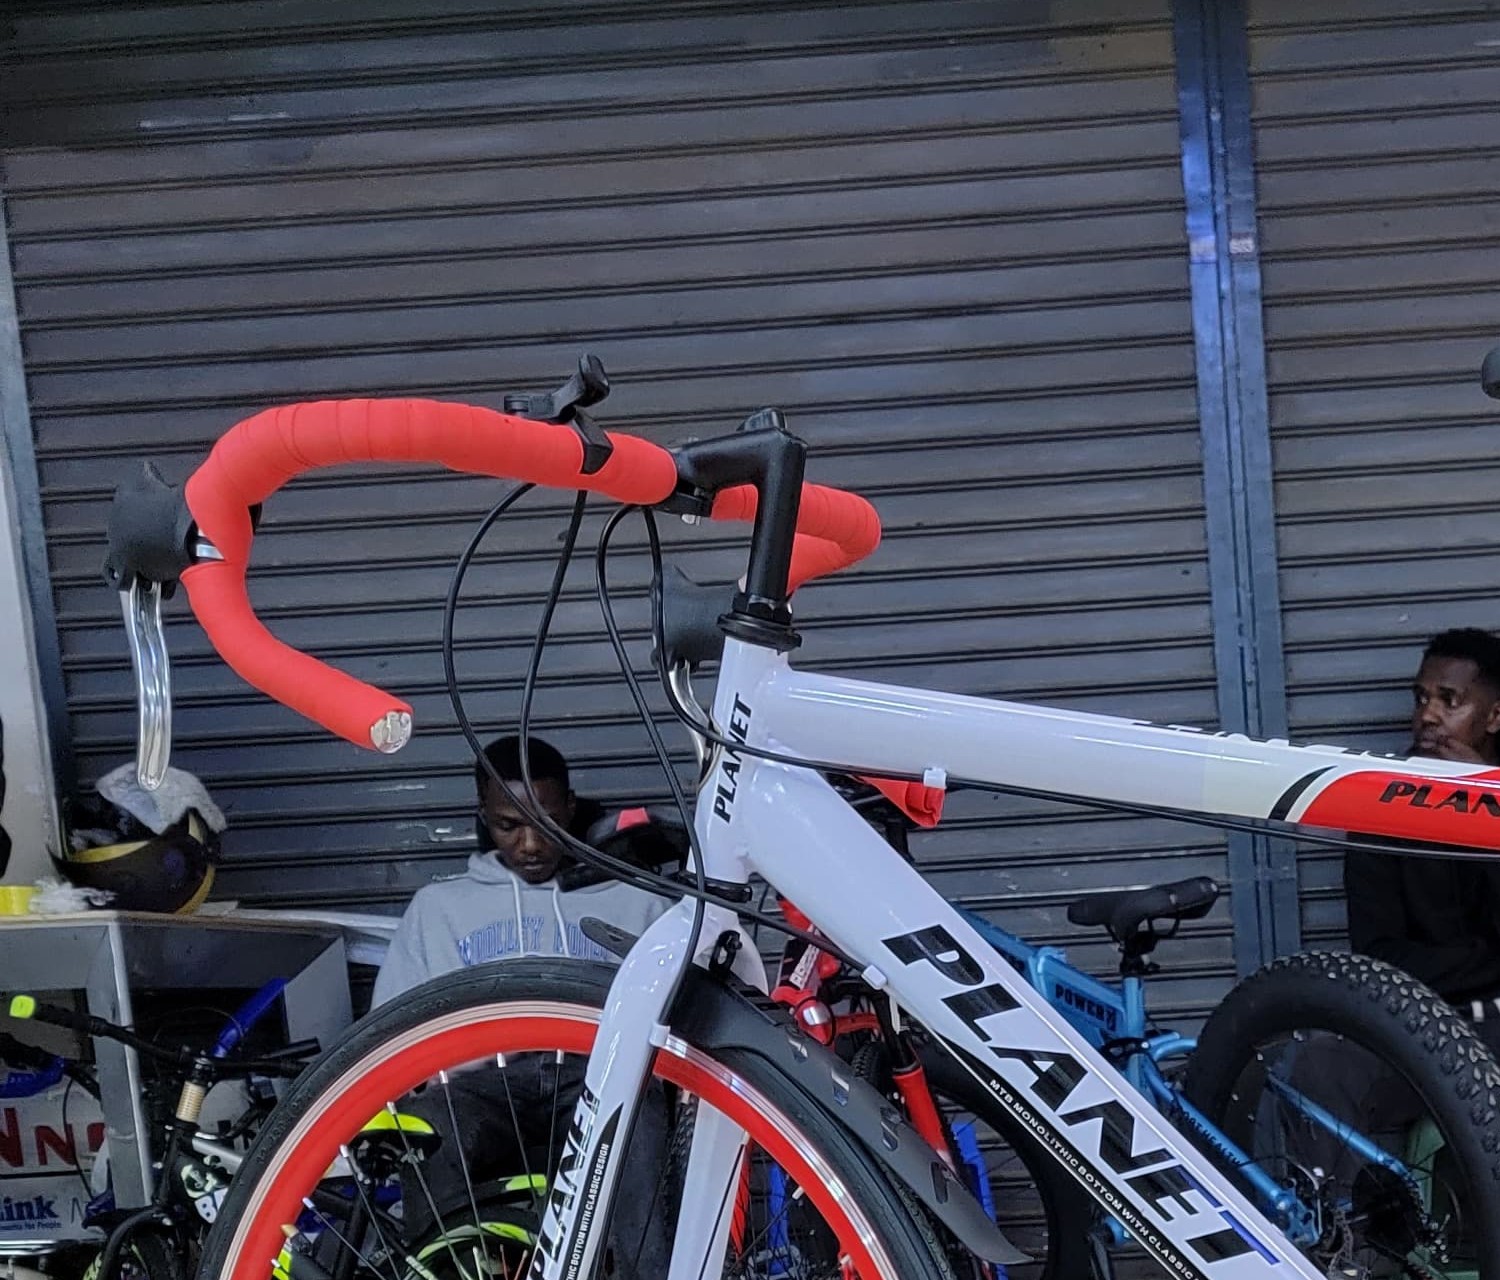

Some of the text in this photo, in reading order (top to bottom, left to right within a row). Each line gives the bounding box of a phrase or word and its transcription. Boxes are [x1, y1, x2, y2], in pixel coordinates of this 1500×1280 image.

[881, 924, 1280, 1265] PLANET
[990, 1079, 1014, 1103] MTB
[1013, 1102, 1079, 1167] MONOLITHIC
[1078, 1166, 1122, 1211] BOTTOM
[1121, 1208, 1149, 1236] WITH
[1148, 1235, 1193, 1279] CLASSIC
